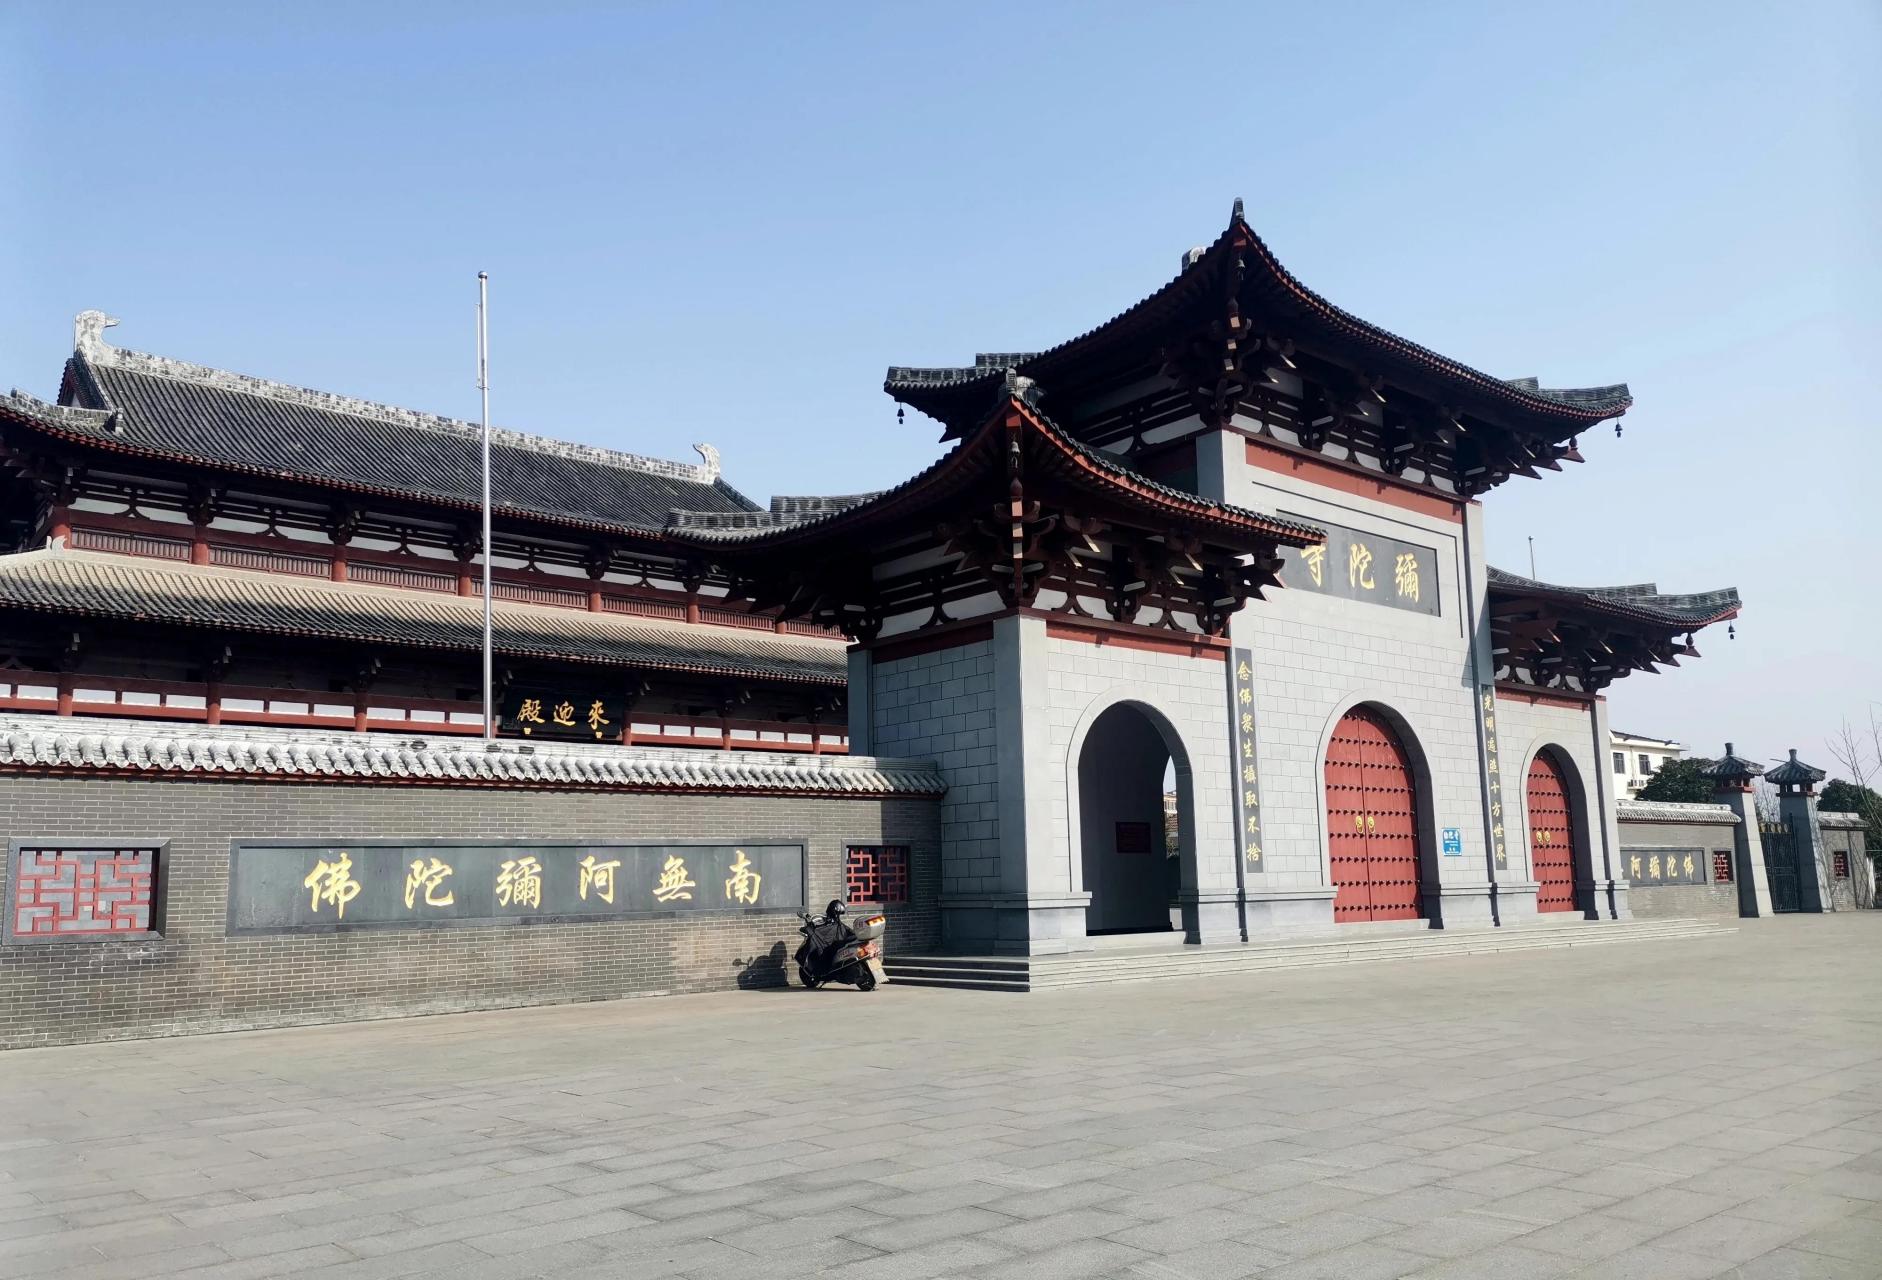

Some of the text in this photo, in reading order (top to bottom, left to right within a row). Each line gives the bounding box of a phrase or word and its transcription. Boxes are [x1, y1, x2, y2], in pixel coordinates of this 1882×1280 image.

[1301, 543, 1419, 602] 彌陀寺
[517, 699, 610, 729] 來迎殿
[304, 850, 762, 918] 南無阿彌陀佛
